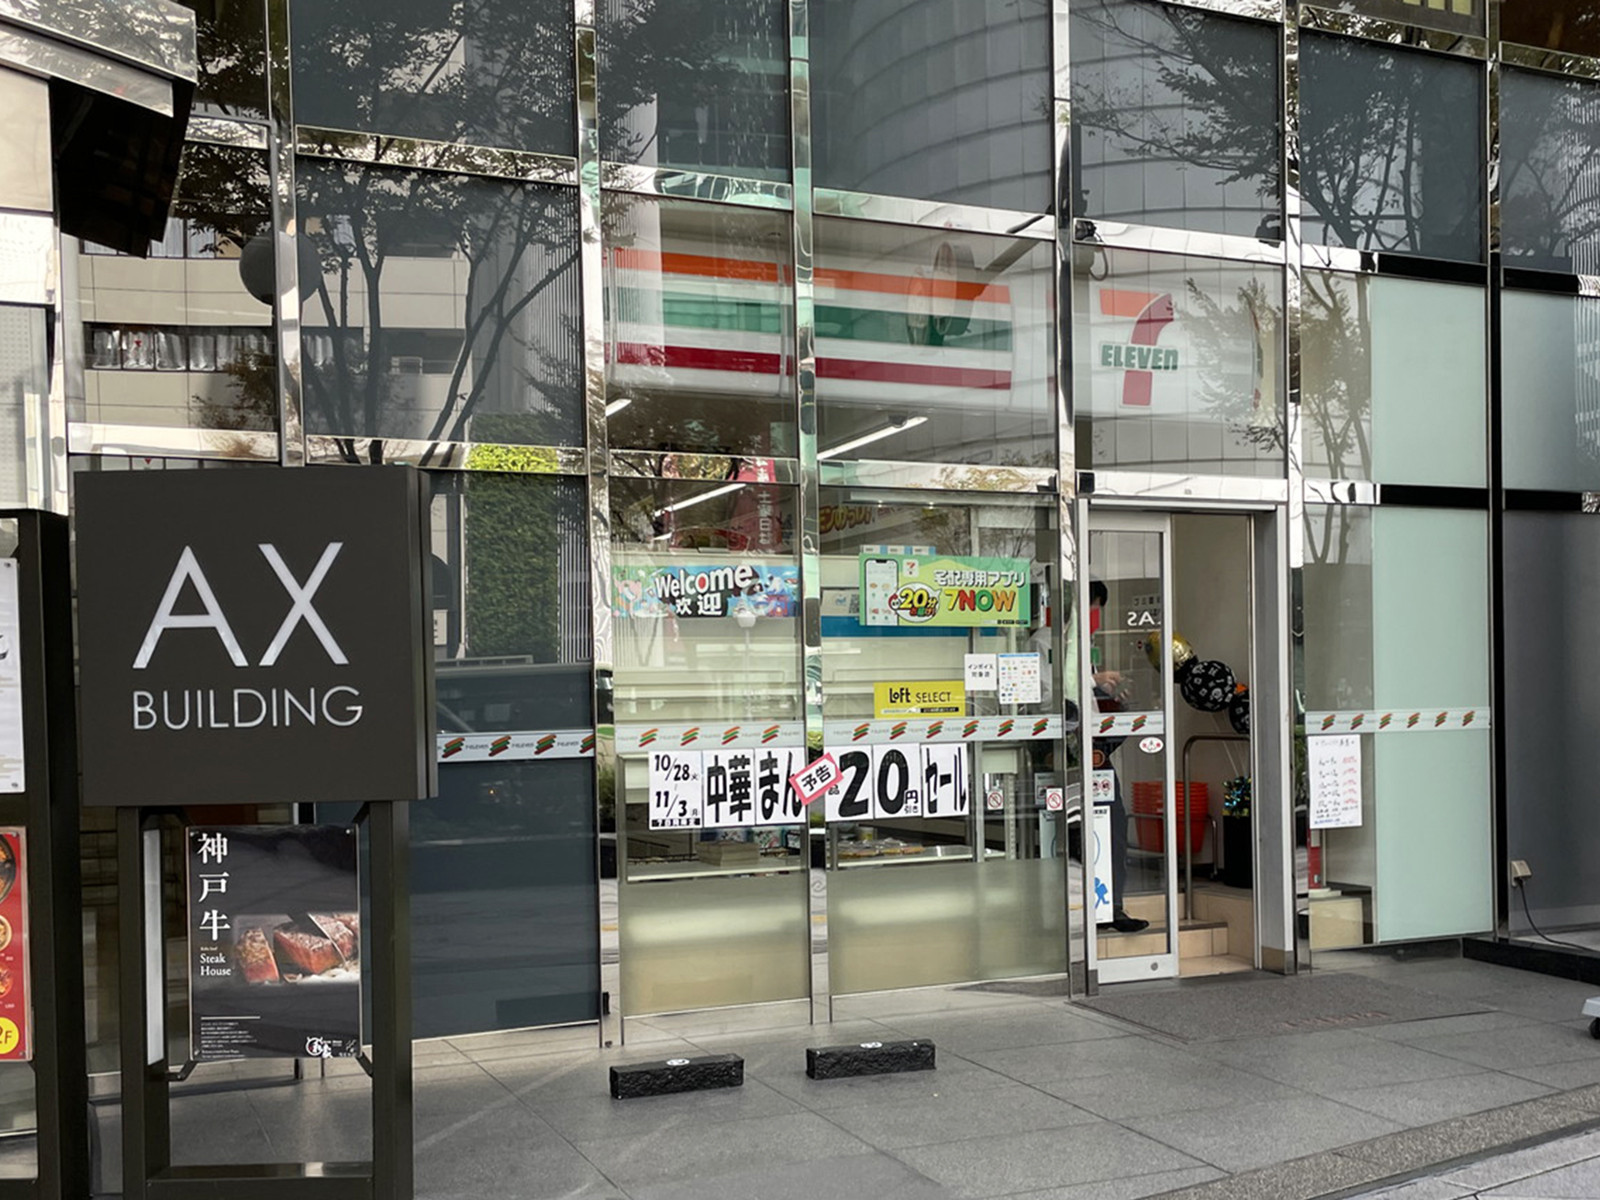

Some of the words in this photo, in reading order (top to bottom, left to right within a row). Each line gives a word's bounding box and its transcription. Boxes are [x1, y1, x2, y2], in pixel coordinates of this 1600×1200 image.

[655, 564, 753, 599] Welcome
[933, 569, 1025, 588] 宅配専用アプリ
[132, 541, 350, 670] AX
[675, 593, 722, 616] 欢迎
[944, 588, 1016, 612] 7NOW
[133, 685, 364, 731] BUILDING
[915, 691, 952, 703] SELECT
[801, 764, 832, 791] 予告
[197, 832, 231, 941] 神戸牛
[200, 952, 226, 964] Steak
[200, 965, 232, 976] House
[0, 1024, 12, 1044] F
